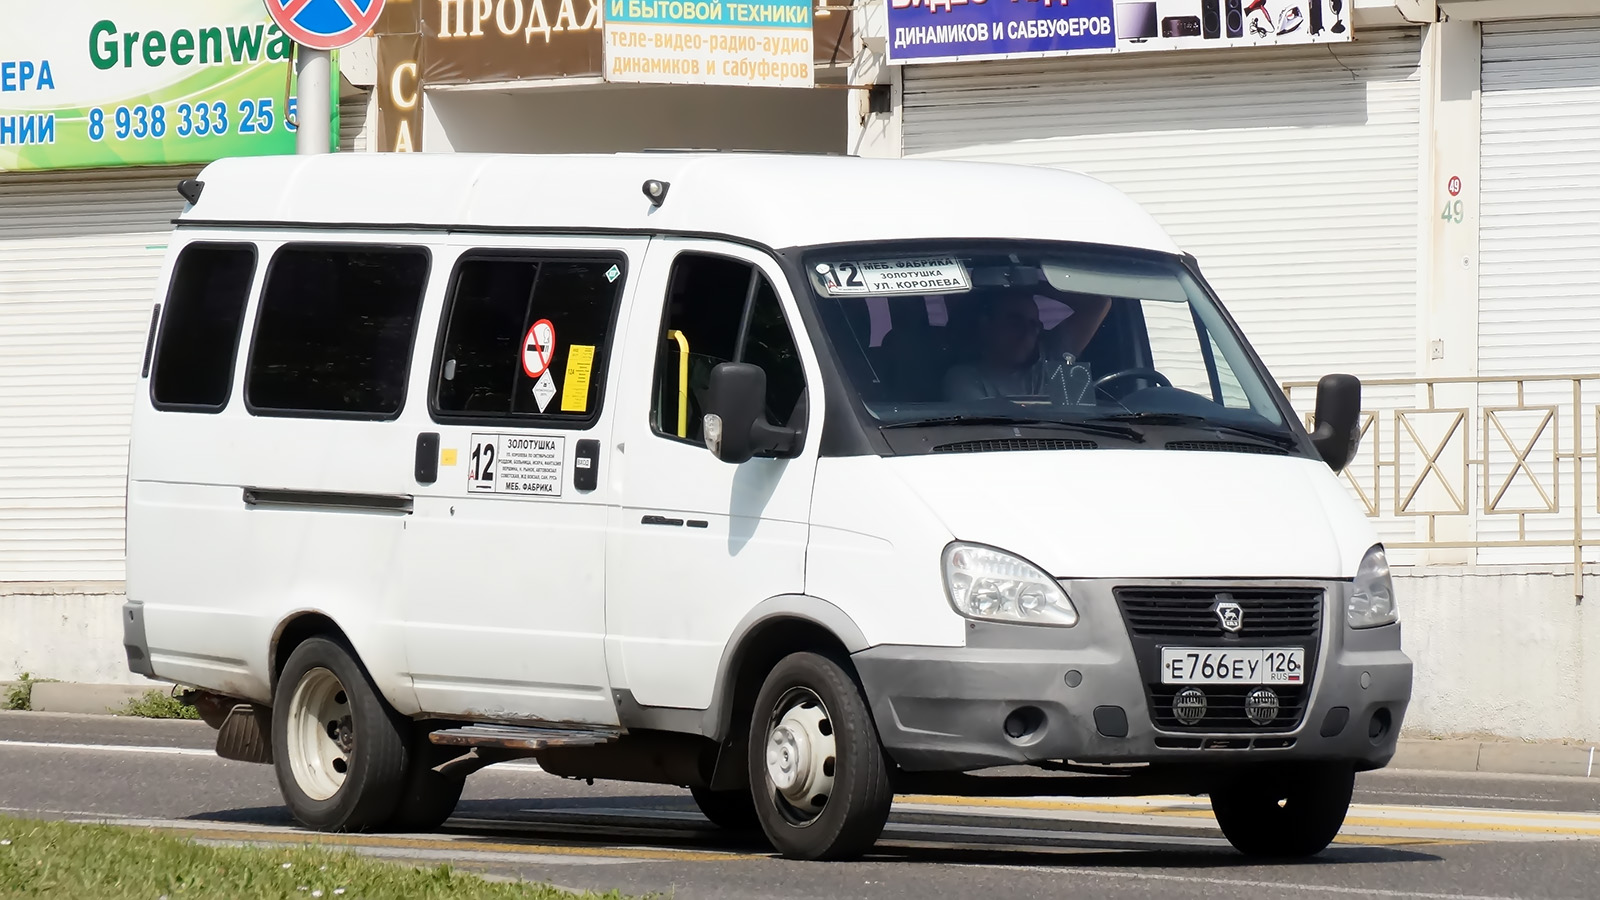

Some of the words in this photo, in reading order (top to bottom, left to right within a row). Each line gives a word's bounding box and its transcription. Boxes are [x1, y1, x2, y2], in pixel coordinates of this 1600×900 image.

[611, 0, 624, 17] И
[629, 0, 722, 20] БЫТОВОЙ
[726, 3, 809, 24] ТЕХНИКИ
[610, 31, 810, 56] теле-видео-радио-аудио
[894, 23, 989, 49] ДИНАМИКОВ
[992, 22, 1004, 41] И
[1007, 16, 1111, 40] САБВУФЕРОВ
[89, 20, 297, 70] Greenwa
[612, 56, 700, 76] динамиков
[706, 60, 717, 76] и
[722, 57, 810, 82] сабуферов
[88, 107, 105, 141] 8
[115, 104, 166, 140] 938
[177, 101, 228, 137] 333
[238, 99, 275, 134] 25
[1449, 178, 1460, 193] 49
[1441, 199, 1464, 224] 49
[896, 257, 954, 269] ФАБРИКА
[873, 282, 894, 291] УЛ.
[897, 278, 961, 290] КОРОЛЕВА
[880, 270, 943, 280] ЗОЛОТУШКА
[507, 438, 556, 451] ЗОЛОТУШКА
[472, 443, 495, 480] 12
[505, 482, 521, 491] МЕБ.
[523, 482, 553, 493] ФАБРИКА
[1265, 652, 1297, 672] 126
[1271, 673, 1288, 681] RUS
